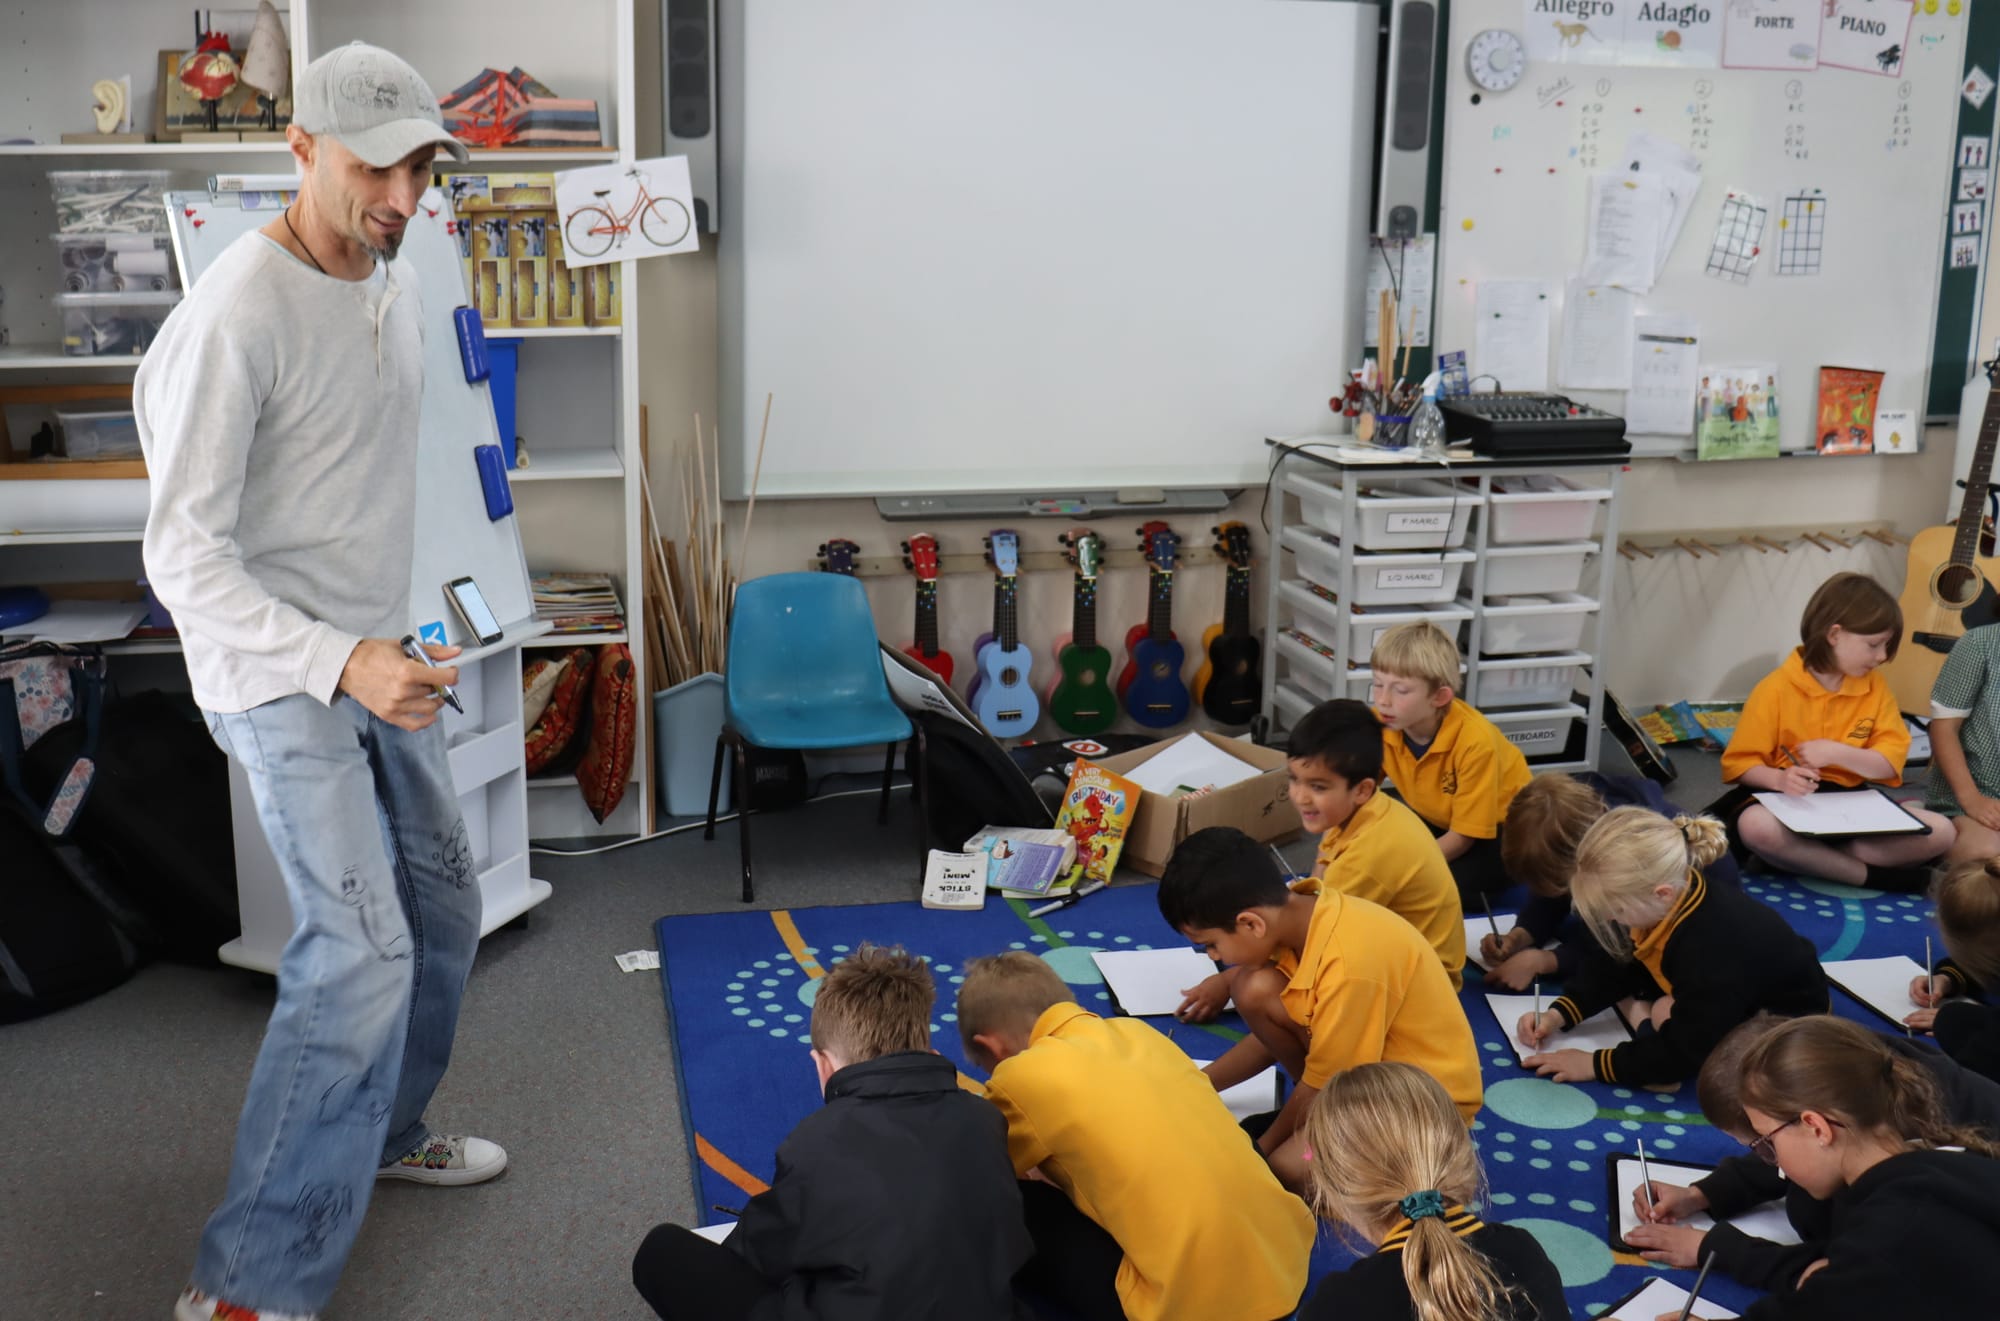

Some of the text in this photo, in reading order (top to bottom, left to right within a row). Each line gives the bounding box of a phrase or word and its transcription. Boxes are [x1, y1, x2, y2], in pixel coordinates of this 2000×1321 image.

[1534, 0, 1614, 20] Allegro
[1638, 2, 1711, 28] Adagio
[1754, 16, 1795, 29] FORTE
[1839, 15, 1887, 36] PIANO
[1405, 573, 1435, 581] MARC
[1505, 730, 1555, 742] ITEBOARDS
[1072, 786, 1120, 806] BIRTHDAY
